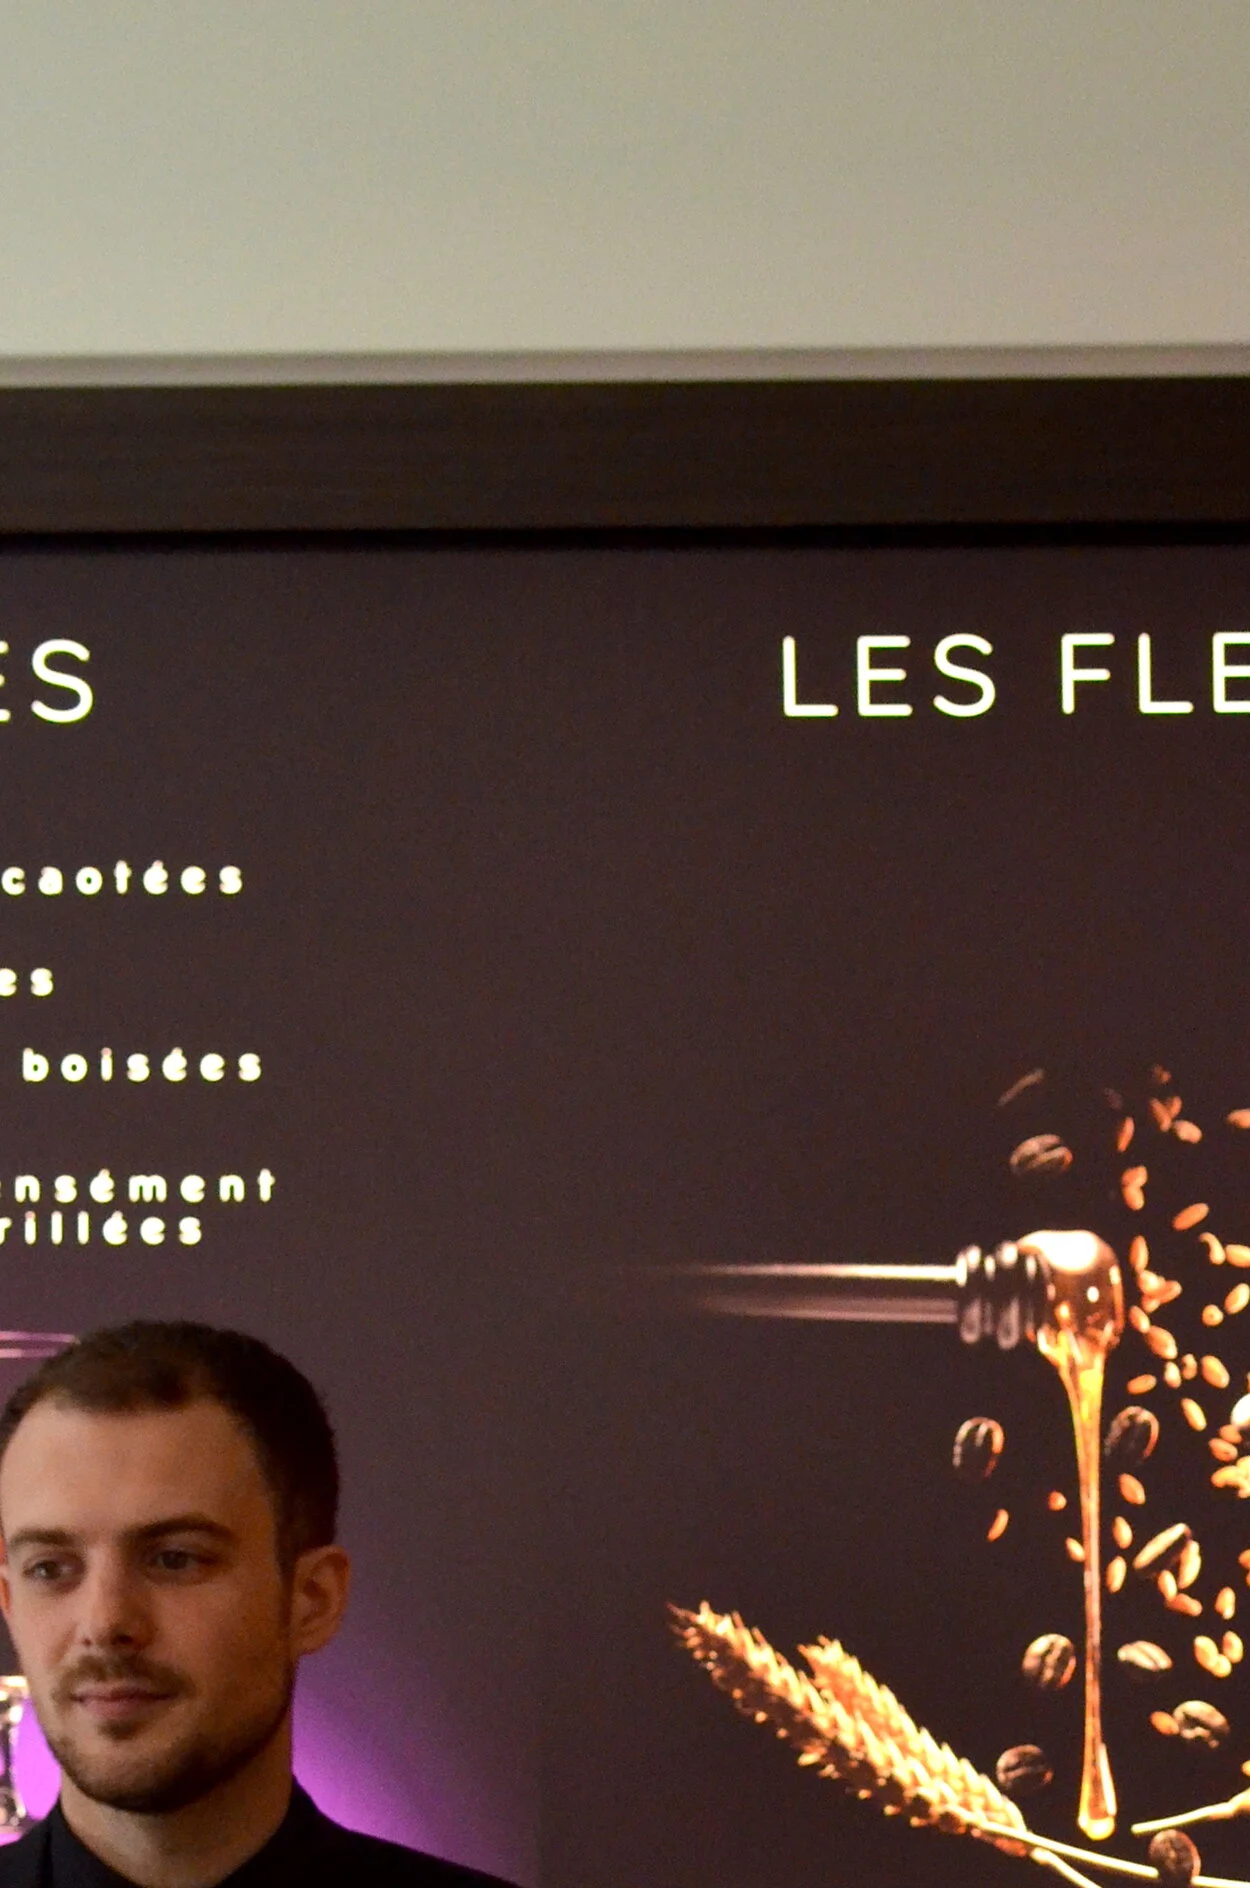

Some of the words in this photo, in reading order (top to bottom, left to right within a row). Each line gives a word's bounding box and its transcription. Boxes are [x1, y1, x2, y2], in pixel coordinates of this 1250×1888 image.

[0, 639, 93, 723] S
[779, 633, 998, 718] LES
[22, 1046, 262, 1083] boisées
[0, 1168, 276, 1204] nsément
